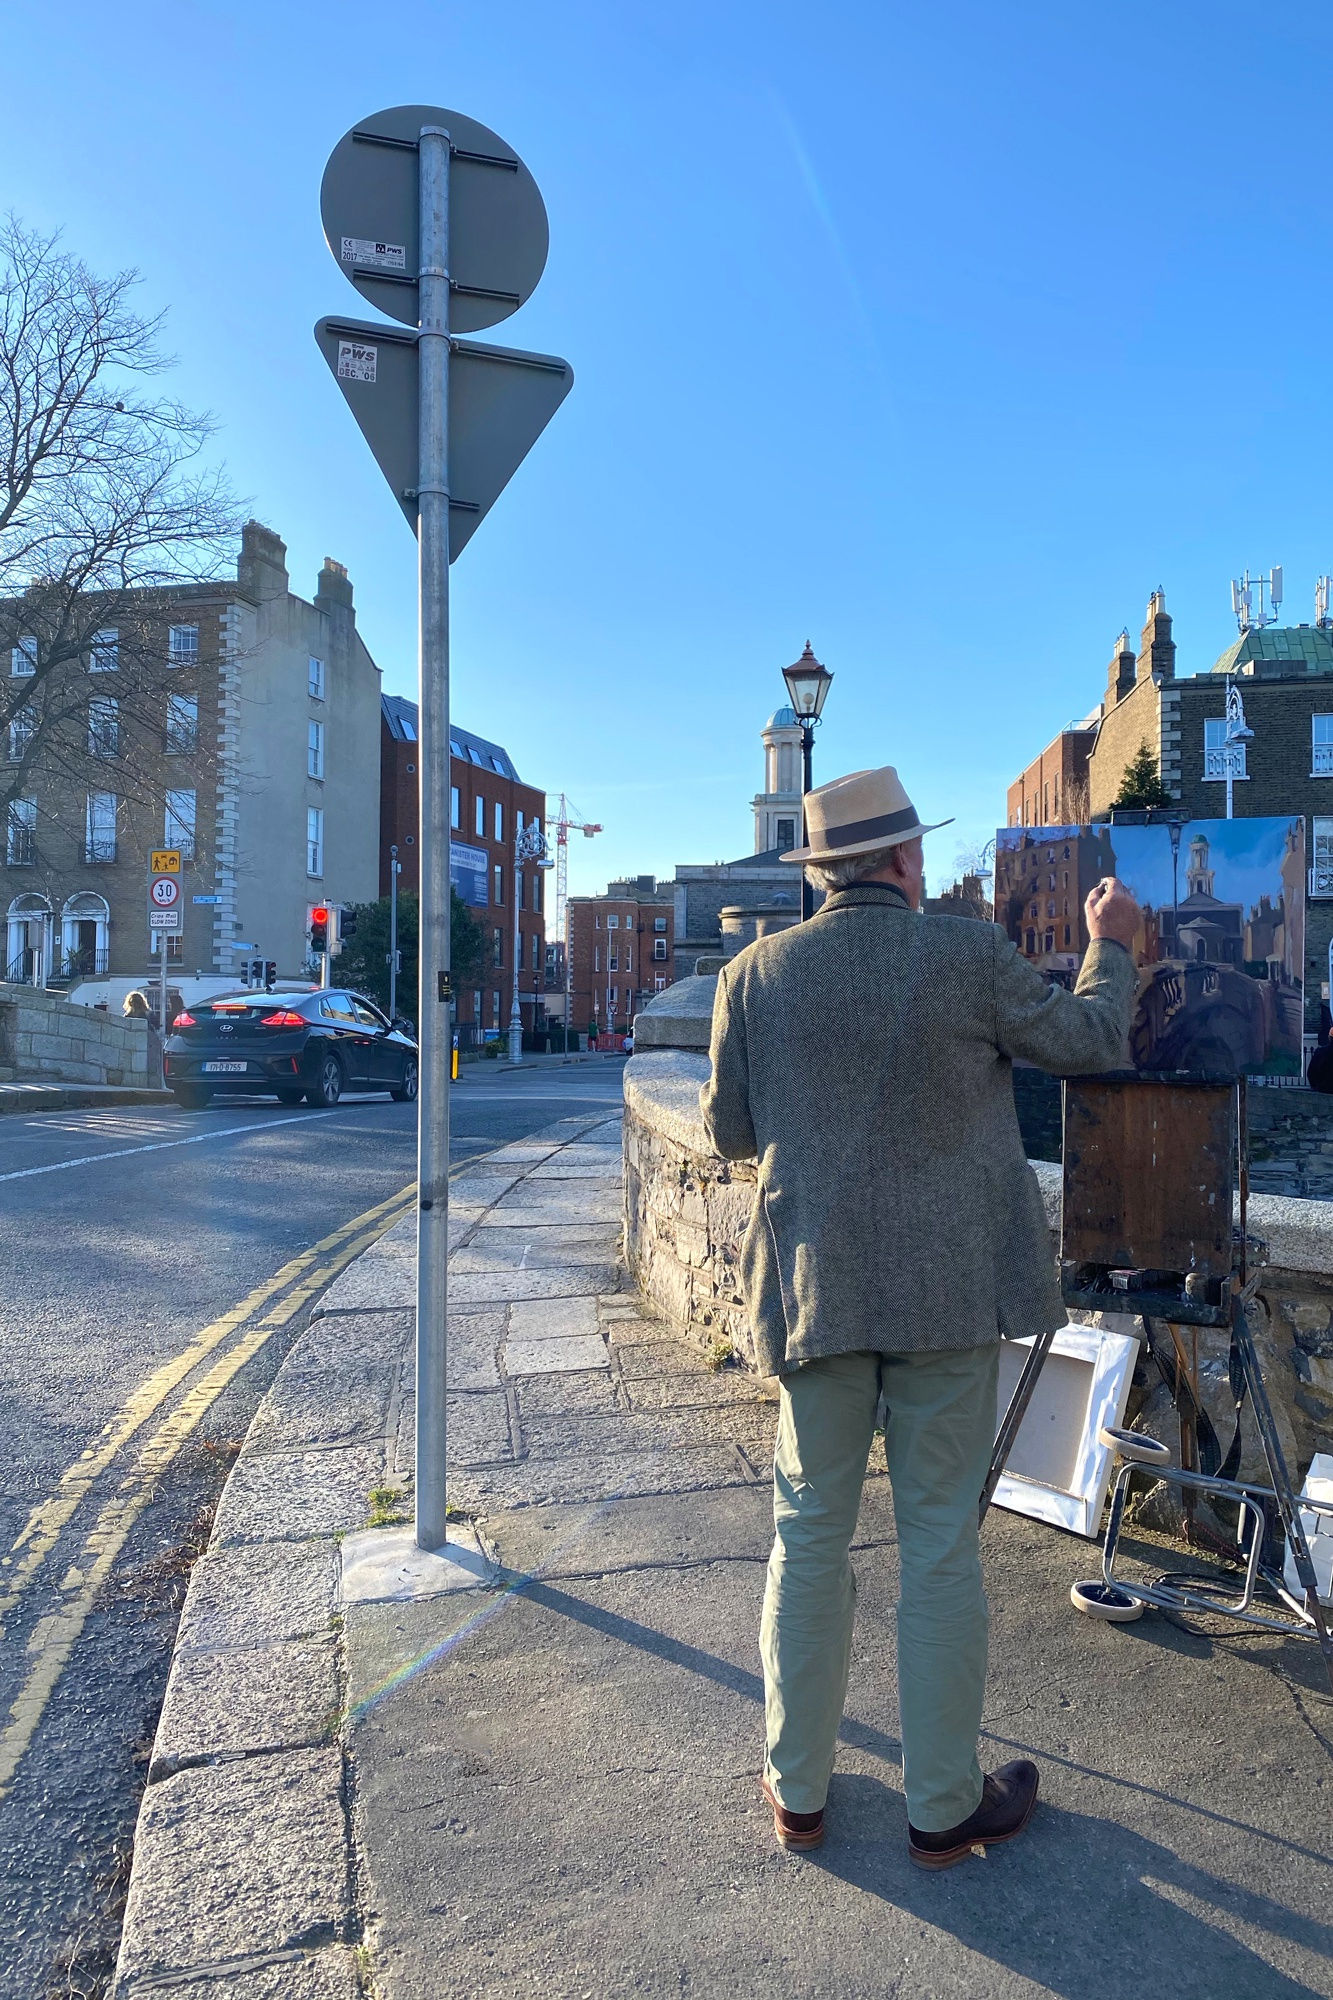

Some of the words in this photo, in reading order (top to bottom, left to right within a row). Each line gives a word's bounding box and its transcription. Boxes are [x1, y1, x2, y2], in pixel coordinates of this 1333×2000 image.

[342, 251, 358, 261] 2017
[340, 347, 375, 361] PWS
[339, 367, 359, 378] DEC.
[157, 884, 172, 897] 30
